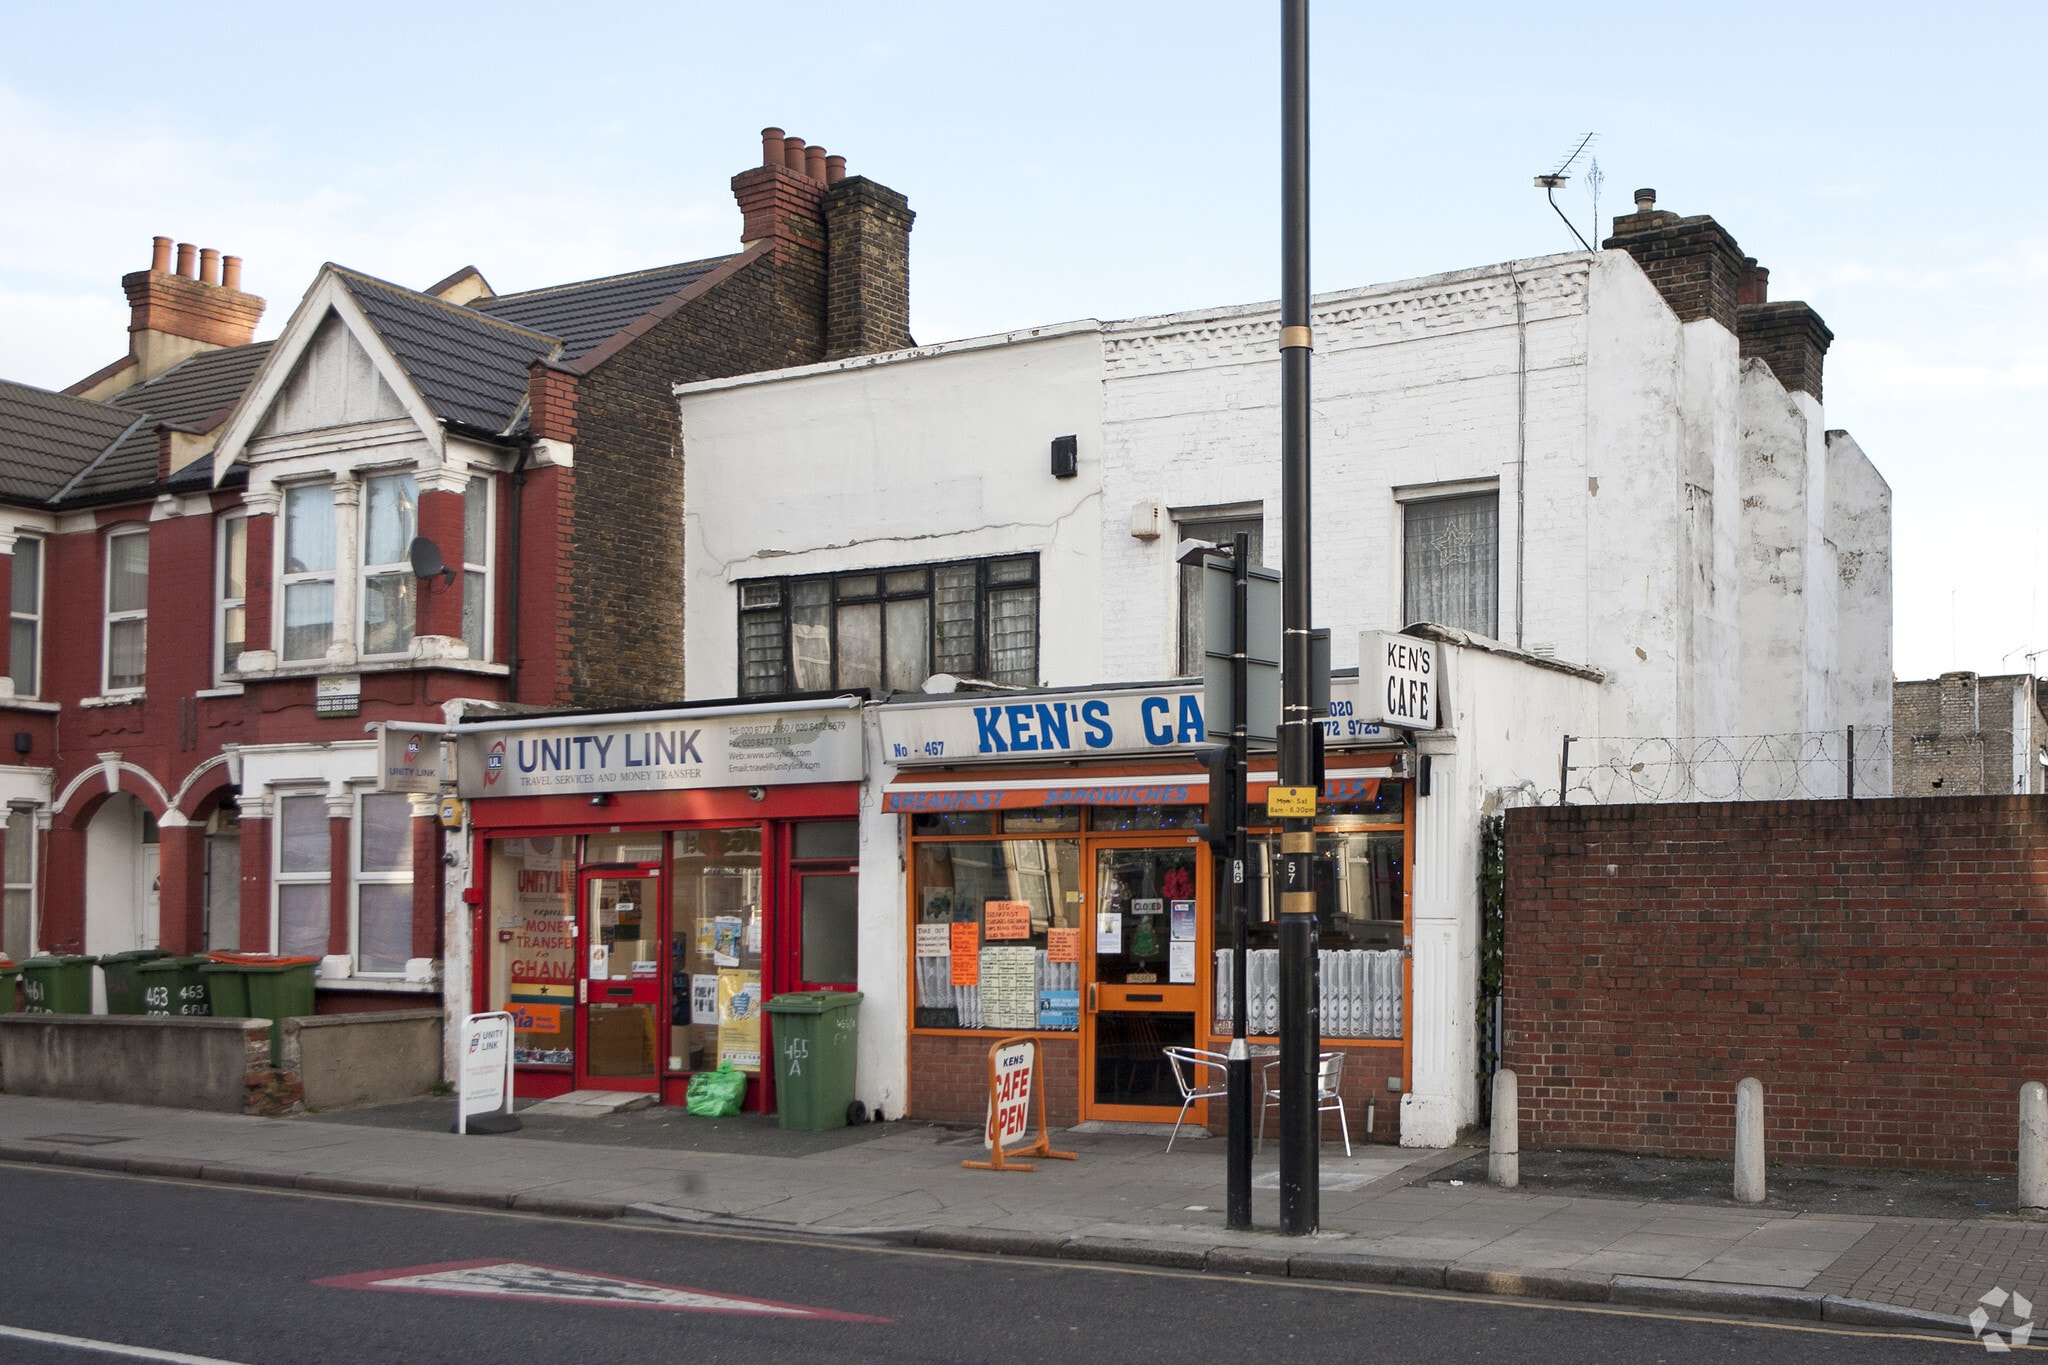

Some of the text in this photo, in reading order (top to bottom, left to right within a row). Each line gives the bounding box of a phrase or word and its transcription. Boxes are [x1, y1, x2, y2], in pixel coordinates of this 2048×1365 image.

[1388, 642, 1431, 674] KEN'S
[1387, 675, 1429, 720] CAFE
[1330, 700, 1353, 717] 020
[741, 726, 754, 735] 020
[796, 723, 808, 732] 020
[973, 699, 1113, 753] KEN'S
[742, 738, 755, 747] 020
[893, 743, 908, 757] No
[924, 741, 945, 755] 467
[518, 729, 703, 773] UNITY LINK
[489, 756, 502, 768] UL
[389, 768, 436, 777] UNITY LINK
[521, 769, 702, 786] TRAVEL SERVICES AND MONEY TRANSFER
[889, 780, 1368, 811] BREAKFAST SANDWICHES LLS
[518, 870, 553, 893] UNITY
[997, 903, 1010, 911] BIG
[525, 920, 570, 933] MONEY
[25, 979, 44, 1000] 461
[146, 986, 168, 1007] 463
[180, 985, 204, 999] 463
[483, 1029, 504, 1039] UNITY
[482, 1041, 499, 1051] LINK
[784, 1037, 809, 1060] 465
[789, 1060, 801, 1076] A
[1003, 1055, 1024, 1068] KENS
